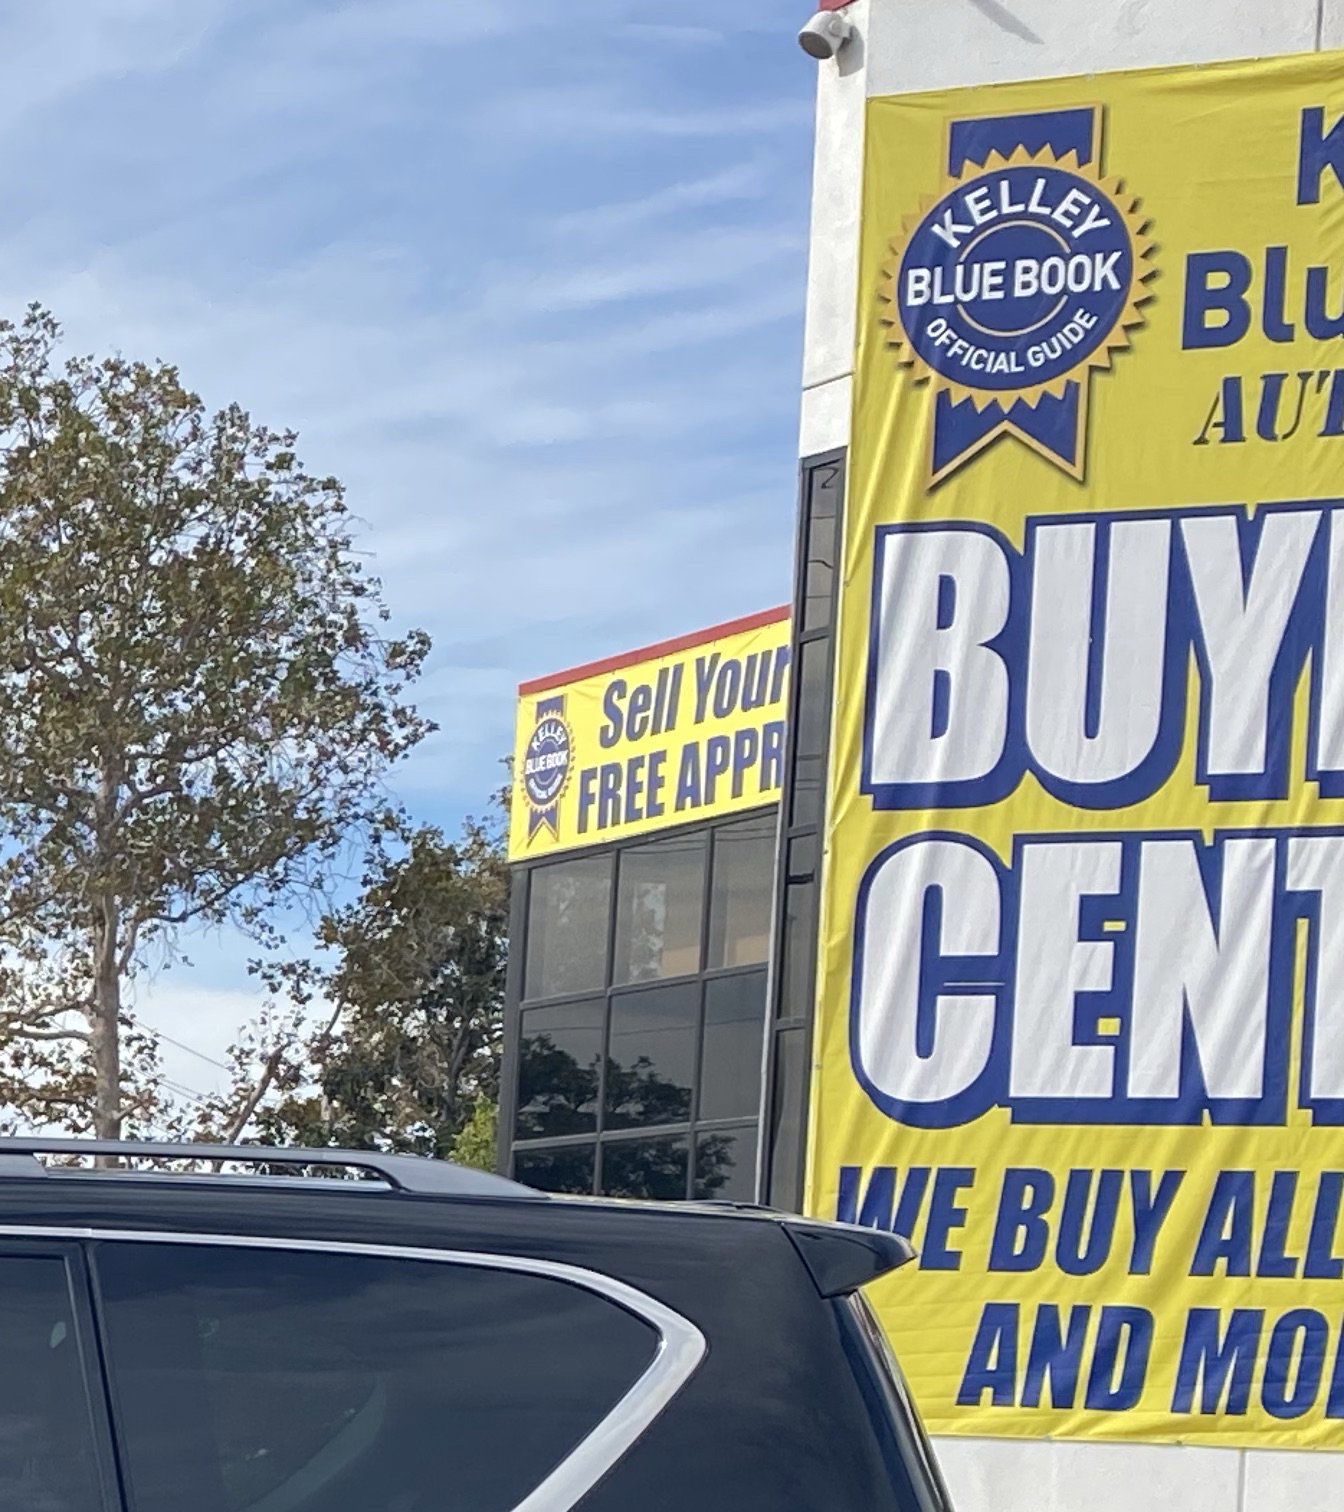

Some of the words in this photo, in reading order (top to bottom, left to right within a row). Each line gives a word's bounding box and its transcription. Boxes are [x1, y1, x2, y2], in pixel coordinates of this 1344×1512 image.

[931, 177, 1111, 249] KELLEY
[906, 260, 1007, 307] BLUE
[1013, 250, 1122, 297] BOOK
[926, 316, 1024, 374] OFFICIAL
[1027, 307, 1097, 368] GUIDE
[531, 722, 567, 751] KELLEY
[599, 662, 684, 748] Sell
[694, 645, 790, 724] Your
[577, 750, 667, 834] FREE
[675, 721, 785, 812] APPR
[836, 1166, 976, 1270] WE
[988, 1168, 1187, 1276] BUY
[1189, 1170, 1344, 1279] ALL
[956, 1302, 1155, 1411] AND
[1170, 1308, 1344, 1420] MO
